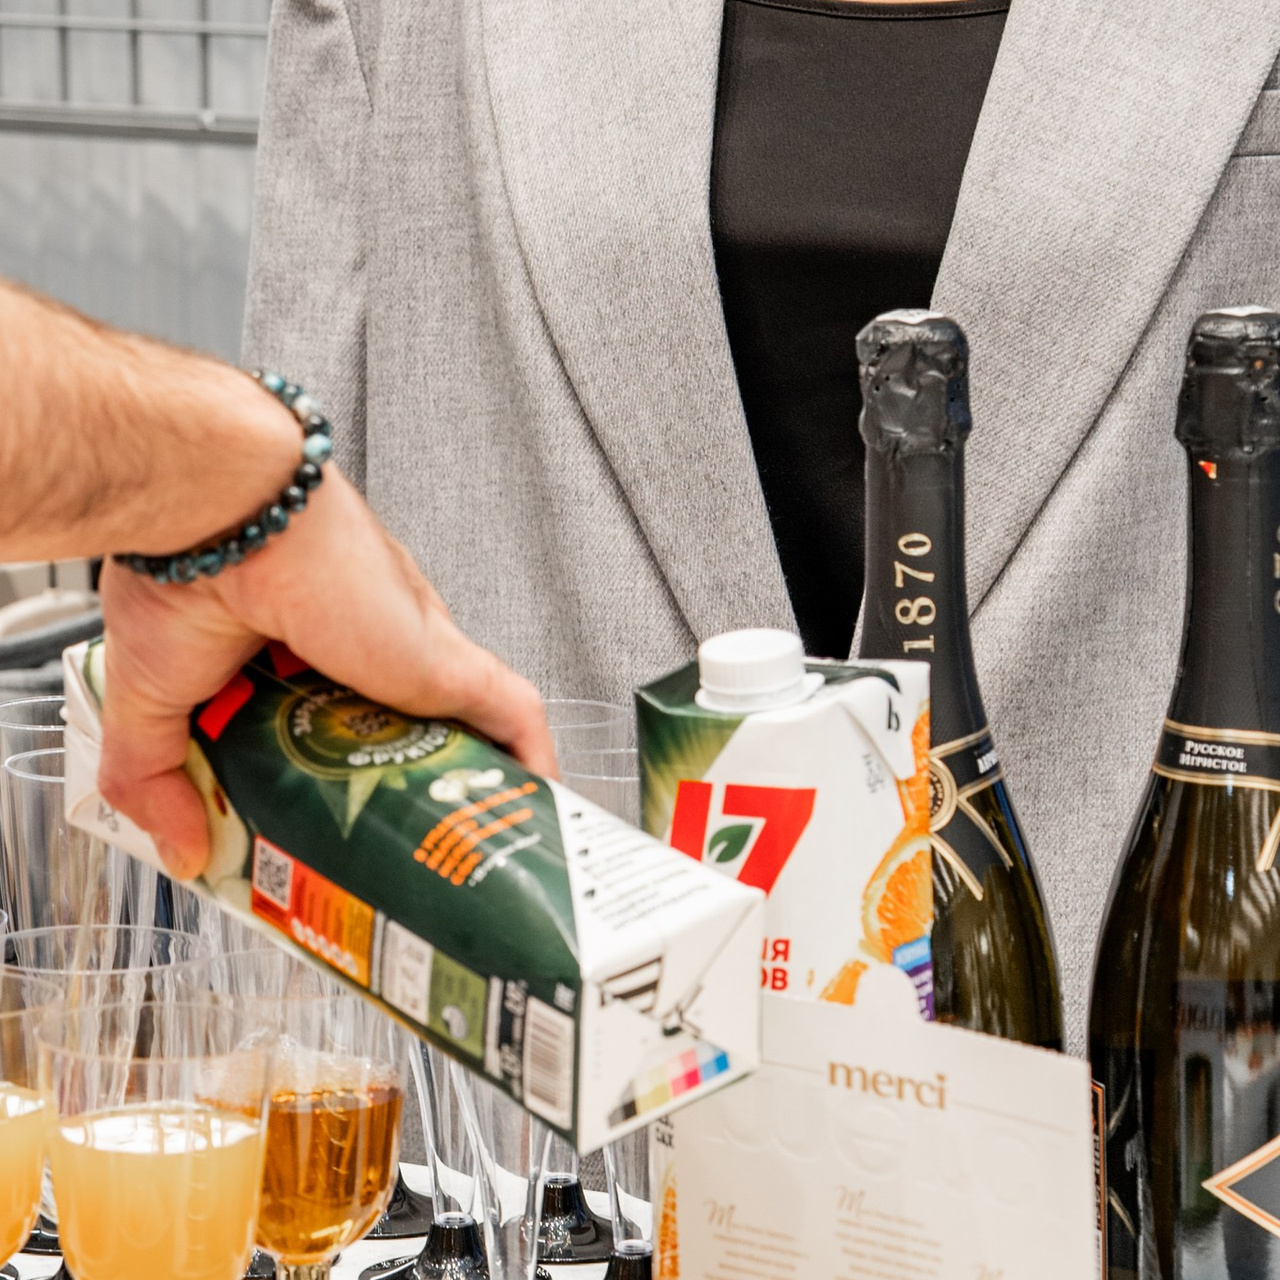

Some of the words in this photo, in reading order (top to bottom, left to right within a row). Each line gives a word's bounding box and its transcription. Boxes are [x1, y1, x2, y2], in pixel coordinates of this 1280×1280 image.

[893, 531, 936, 654] 1870
[1179, 753, 1248, 773] ИГРИСТОЕ
[828, 1061, 947, 1111] merci
